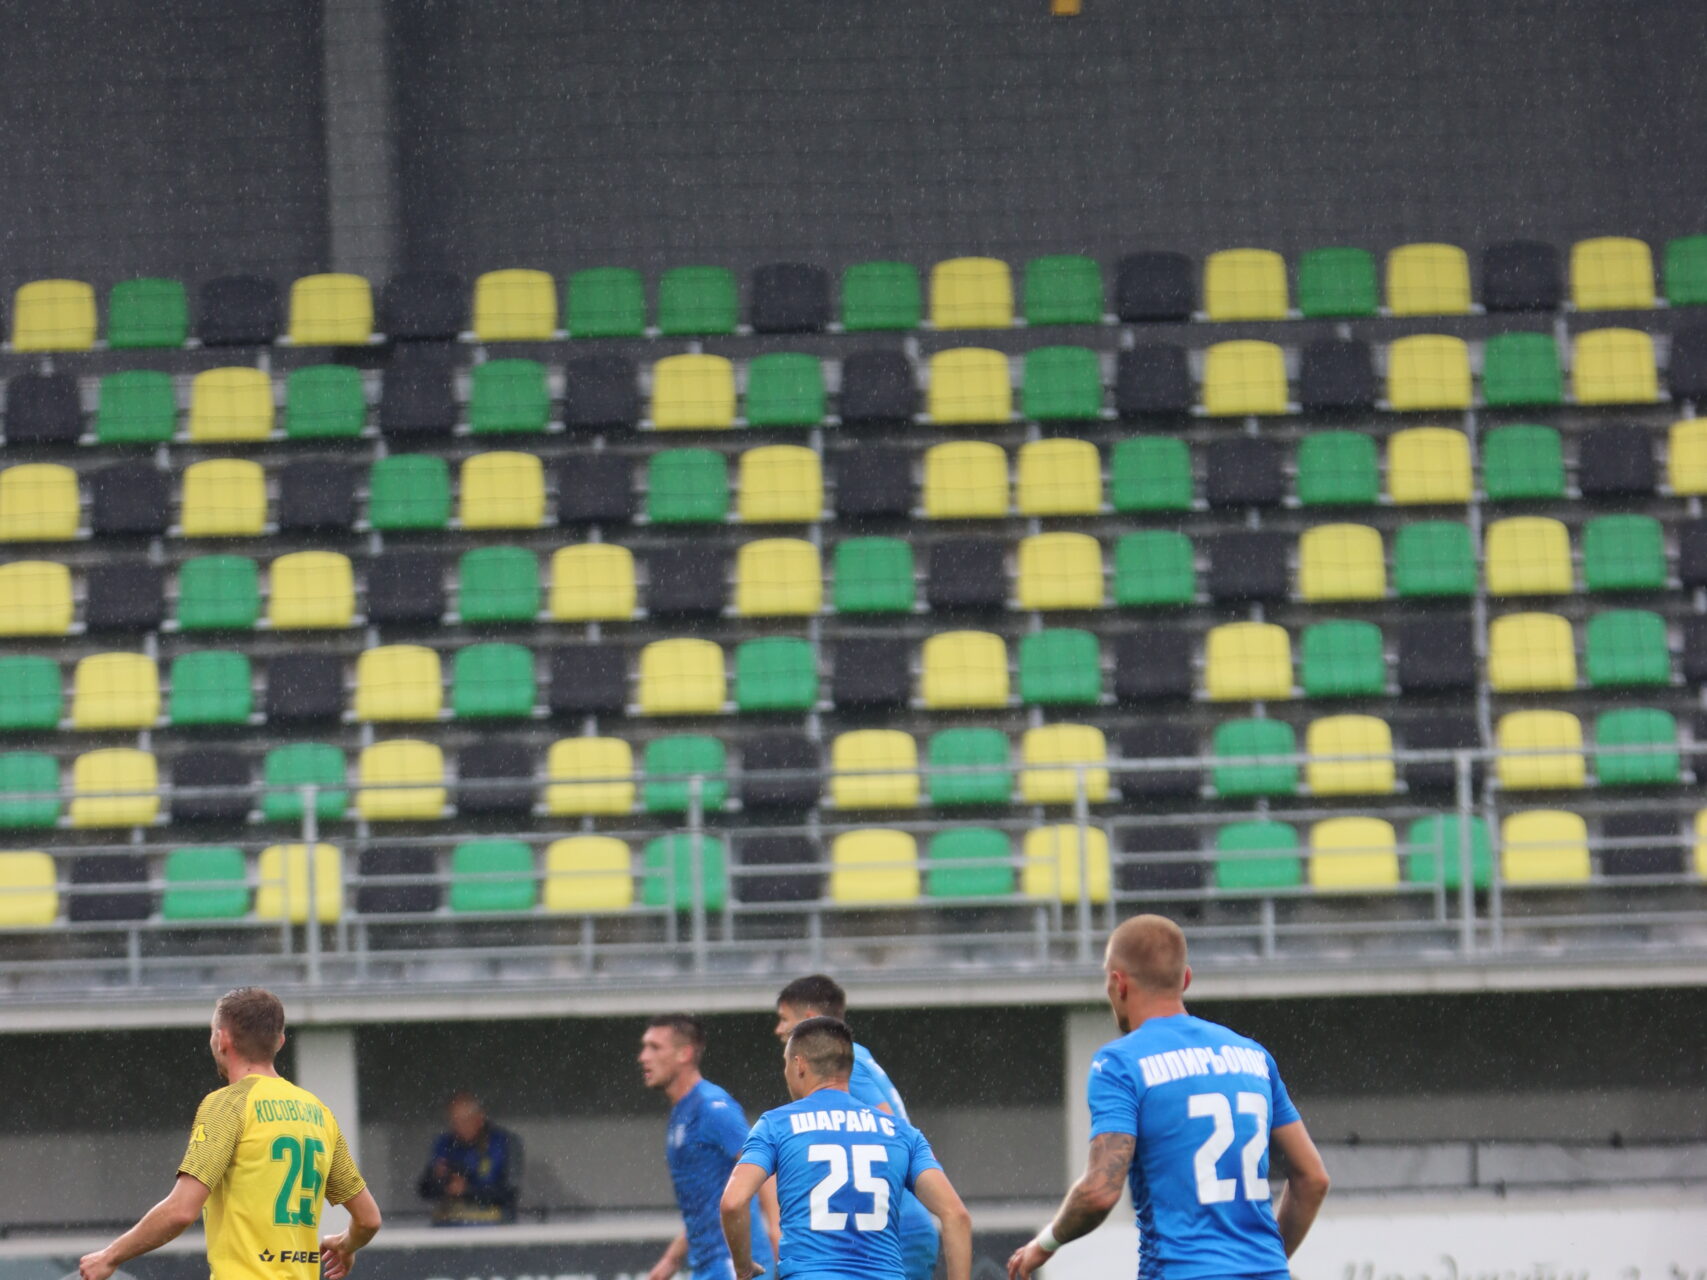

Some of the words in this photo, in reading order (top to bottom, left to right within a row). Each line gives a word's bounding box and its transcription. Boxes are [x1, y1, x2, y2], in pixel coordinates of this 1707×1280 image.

[790, 1108, 878, 1135] ШАРАЙ
[1188, 1091, 1271, 1205] 22
[270, 1133, 326, 1229] 25
[807, 1143, 891, 1232] 25
